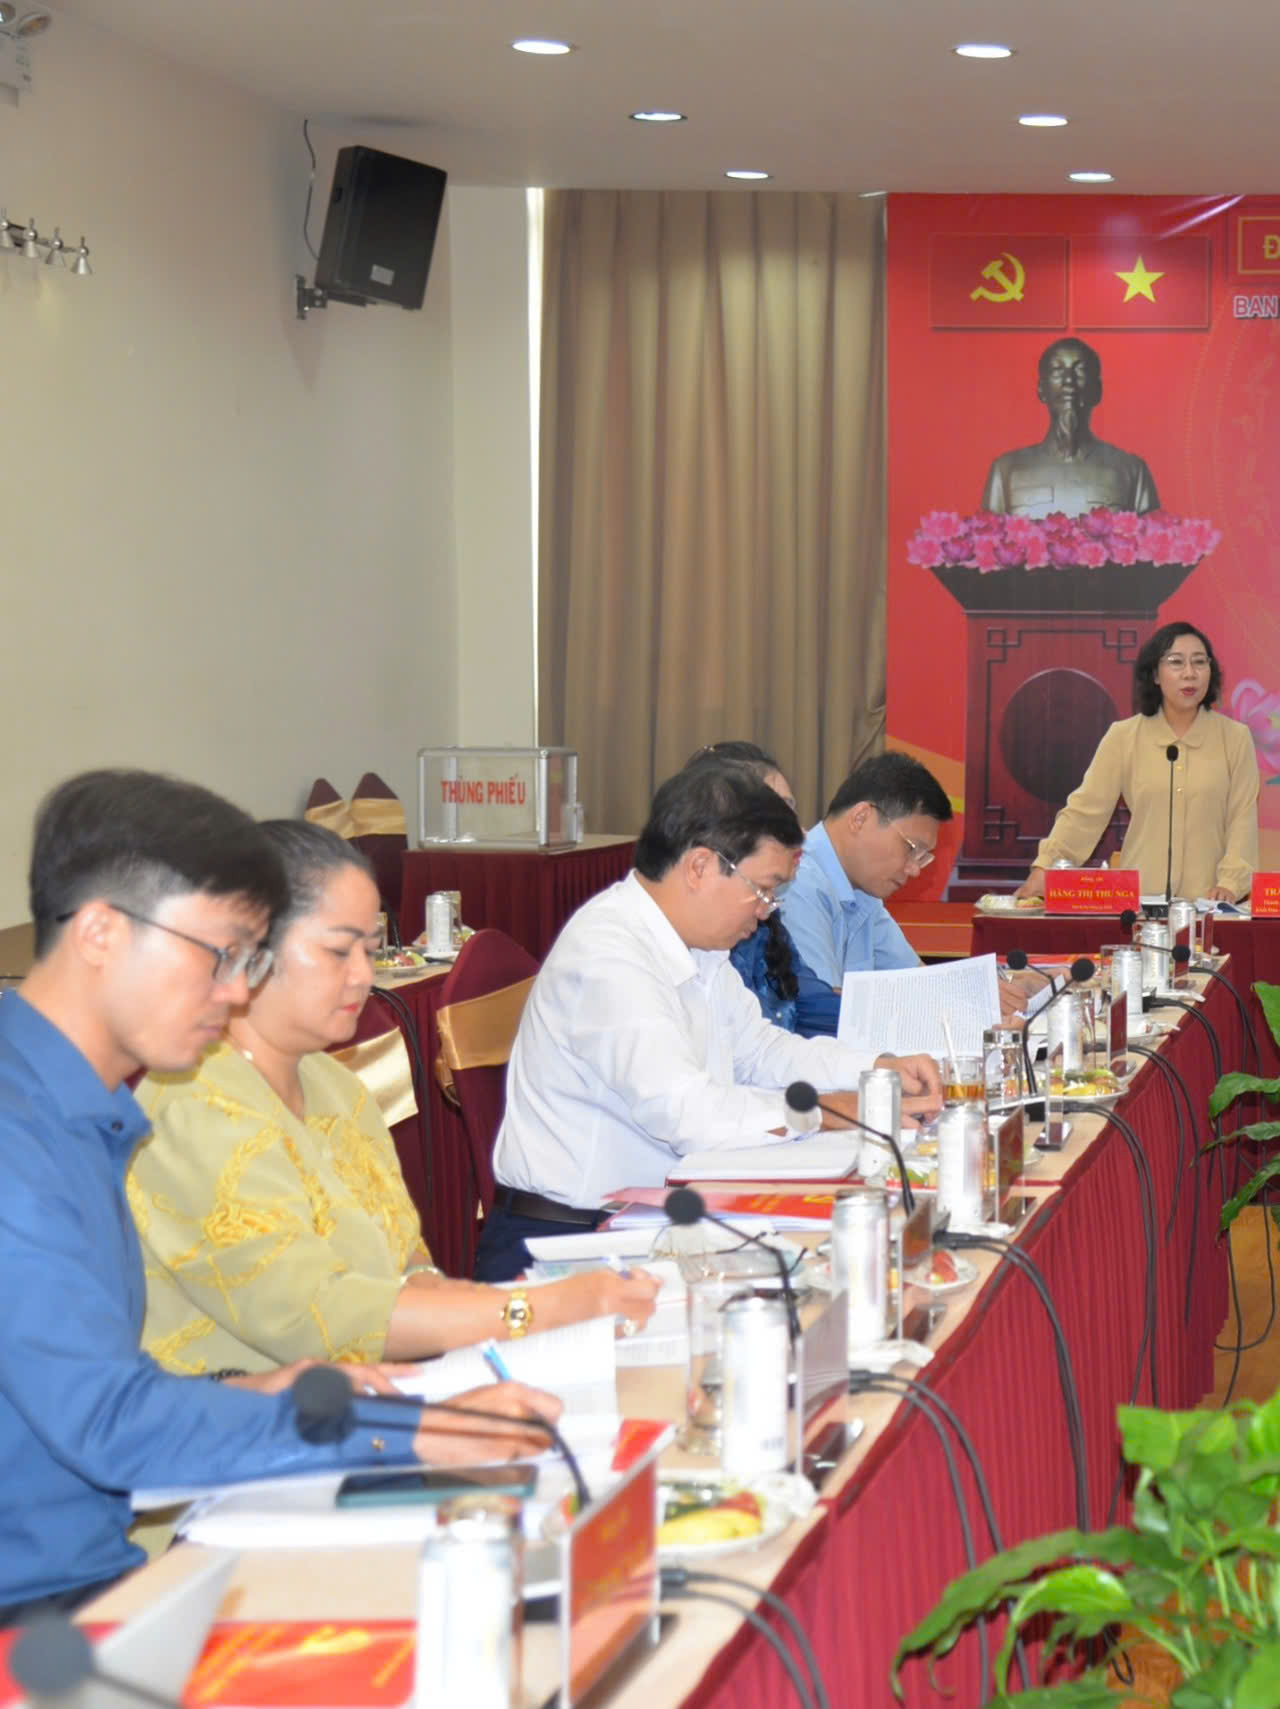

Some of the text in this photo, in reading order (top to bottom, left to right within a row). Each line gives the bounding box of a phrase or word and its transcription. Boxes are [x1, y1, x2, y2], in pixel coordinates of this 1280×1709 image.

[1232, 295, 1279, 318] BAN
[440, 775, 527, 805] THÙNG PHIẾU
